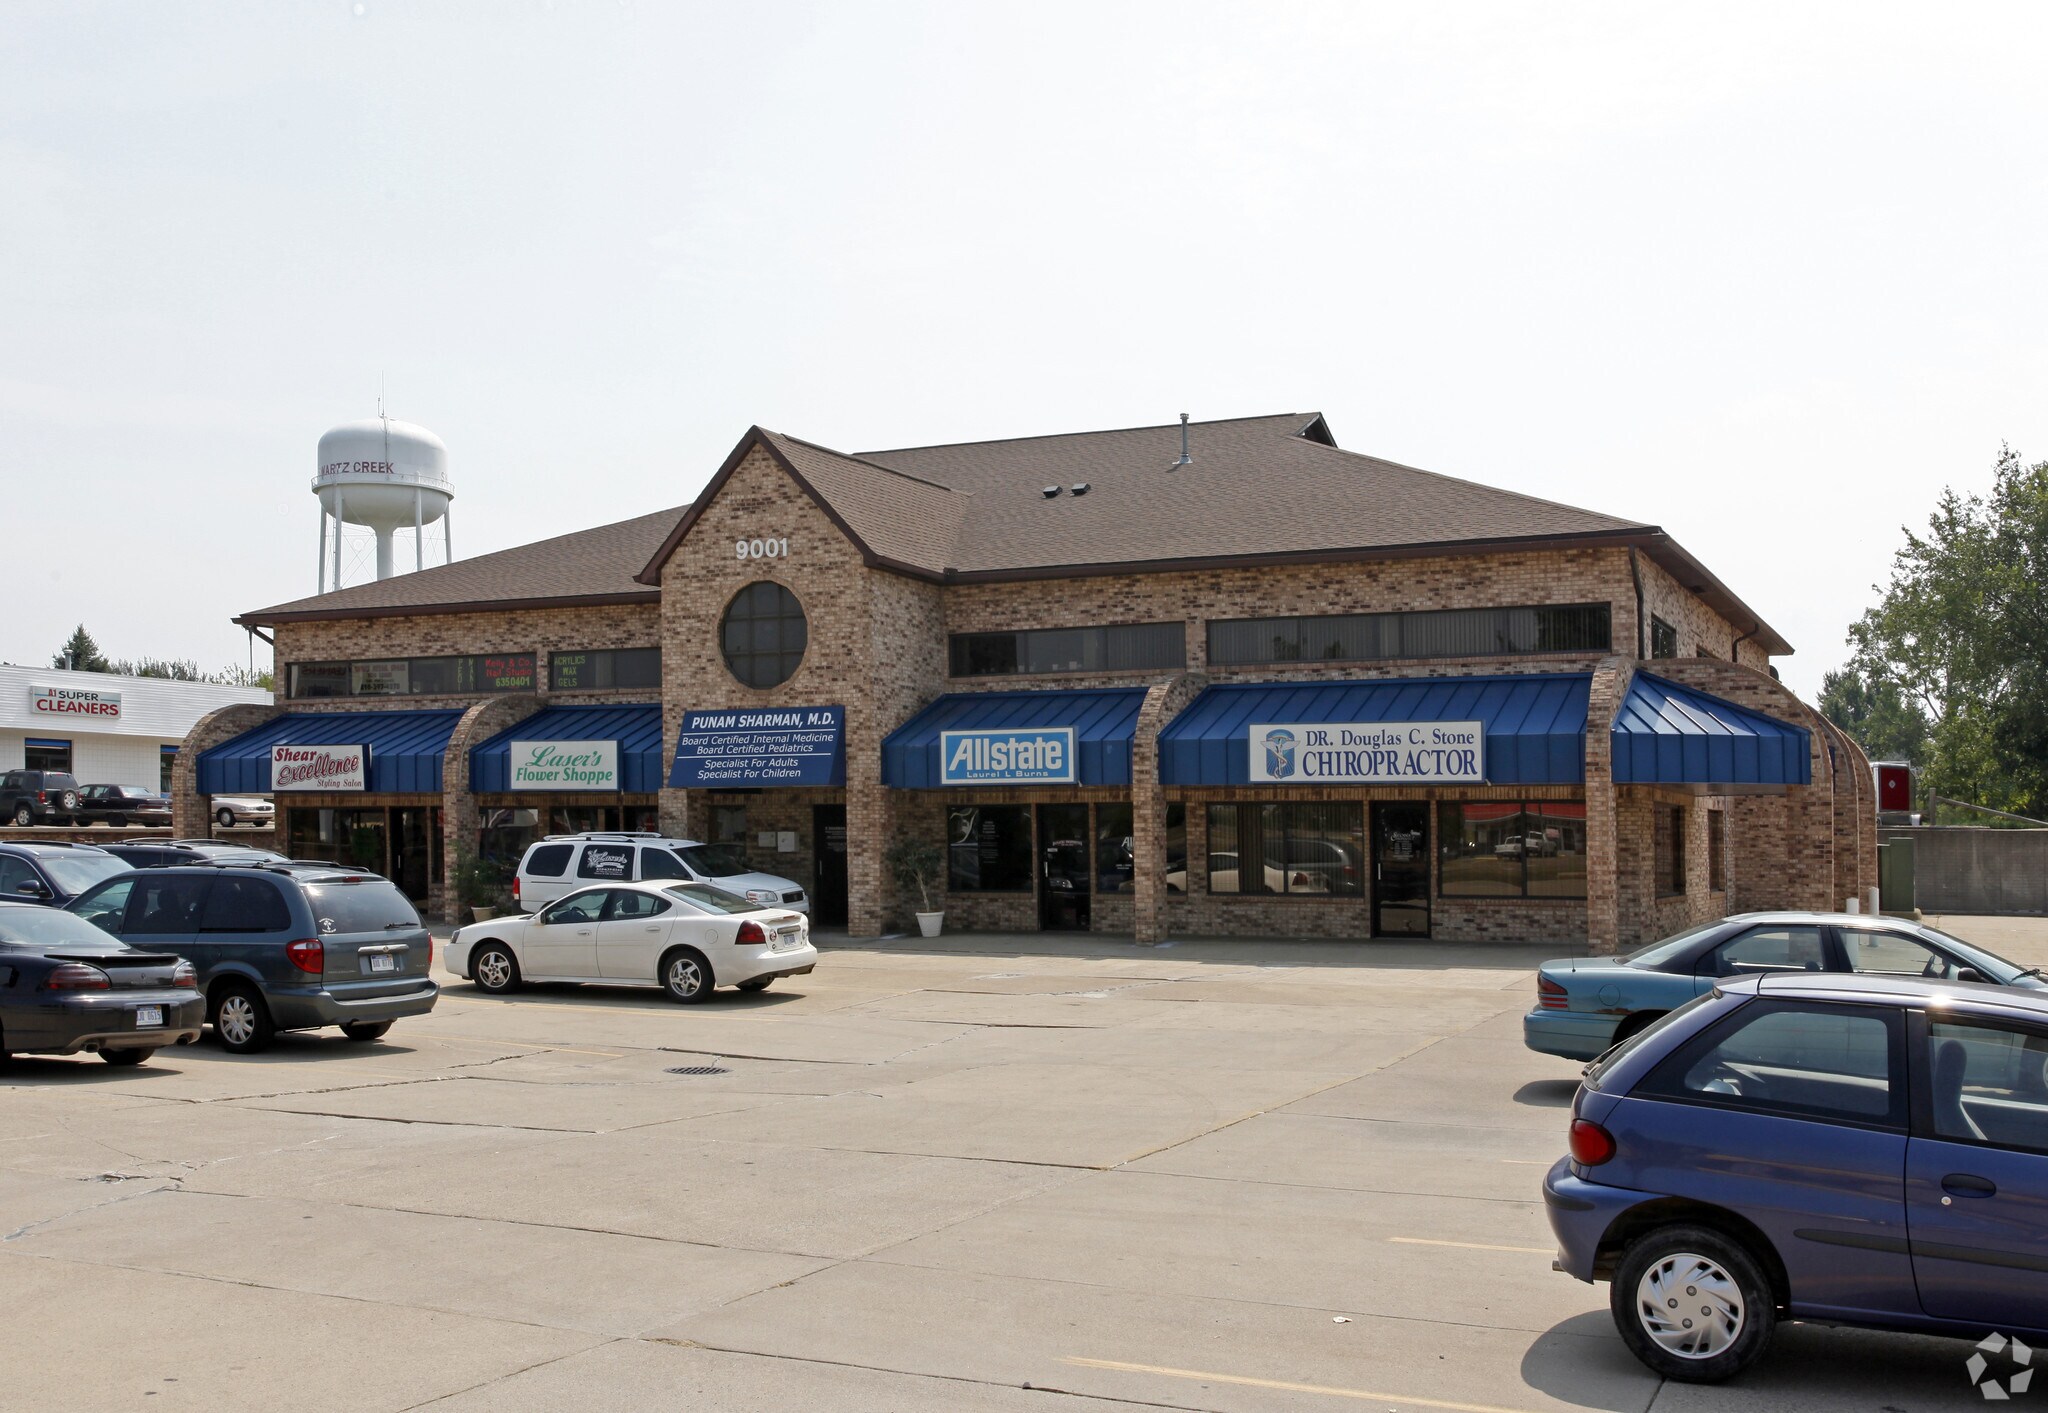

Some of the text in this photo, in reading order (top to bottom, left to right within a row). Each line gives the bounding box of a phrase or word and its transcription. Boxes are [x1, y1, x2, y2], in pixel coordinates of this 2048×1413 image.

[353, 462, 394, 474] CREEK
[736, 537, 788, 560] 9001
[554, 655, 585, 665] ACRYLICS
[505, 667, 533, 676] Studio
[563, 667, 577, 675] WAX
[495, 676, 530, 687] 6350401
[558, 678, 577, 687] GELS
[58, 691, 99, 701] SUPER
[36, 699, 119, 716] CLEANERS
[691, 712, 835, 729] PUNAM SHARMAN, M.D.
[682, 733, 834, 746] Board Certified Internal Medicine
[1305, 727, 1475, 749] DR. Douglas C. Stone
[274, 748, 317, 762] Shear
[696, 743, 814, 755] Board Certified Pediatrics
[948, 736, 1063, 771] Allstate
[525, 745, 602, 768] Laser's
[1302, 749, 1478, 777] CHIROPRACTOR
[276, 752, 361, 787] Excellence
[704, 758, 799, 770] Specialist For Adults
[516, 767, 613, 785] Flower Shoppe
[697, 768, 801, 781] Specialist For Children
[317, 779, 362, 788] Styling Salon
